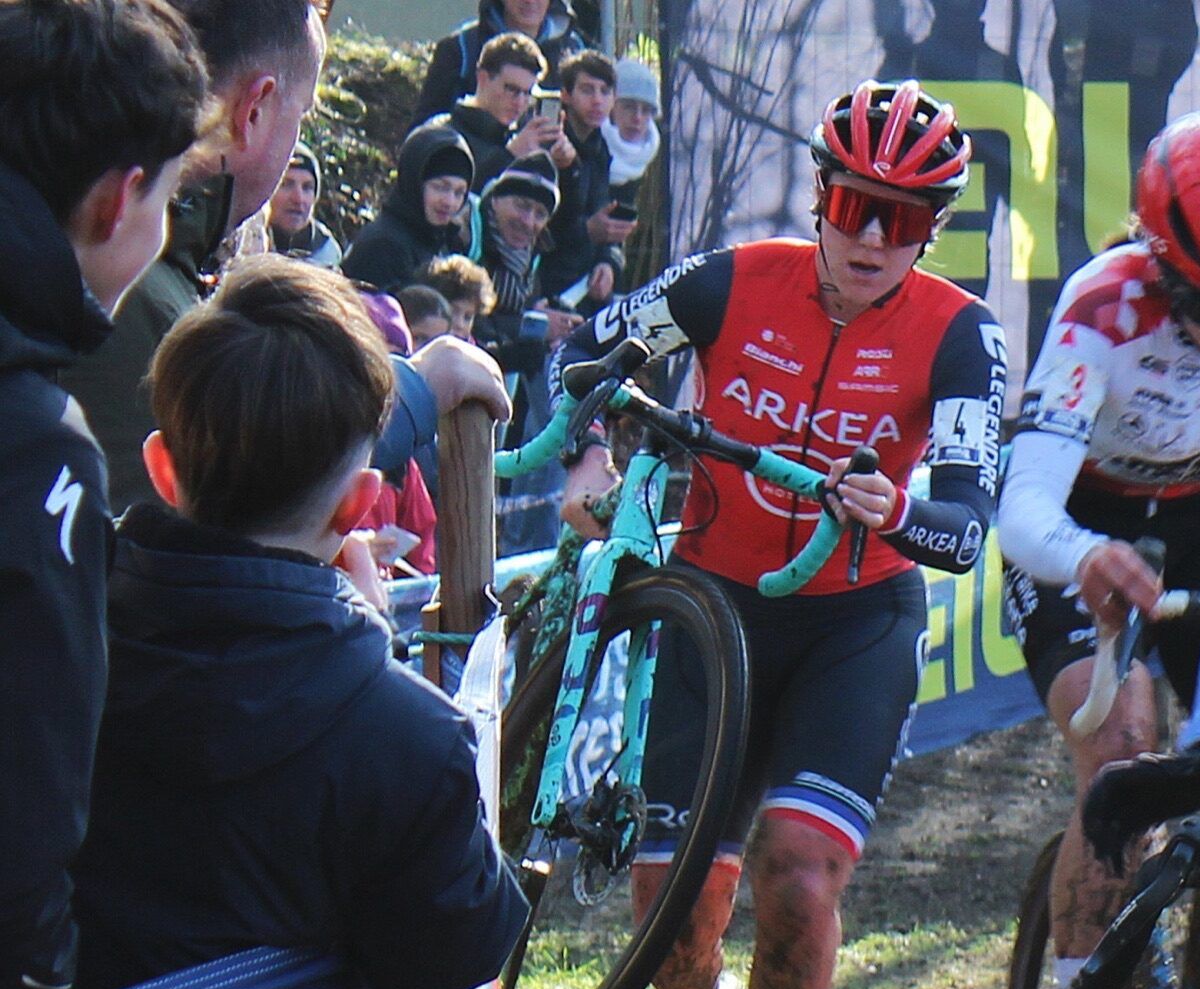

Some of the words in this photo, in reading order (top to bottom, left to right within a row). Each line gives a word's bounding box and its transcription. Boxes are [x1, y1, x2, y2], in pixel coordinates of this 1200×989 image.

[721, 376, 902, 447] ARKEA
[954, 401, 967, 444] 4
[978, 363, 1007, 498] LEGENDRE
[903, 524, 959, 554] ARKEA
